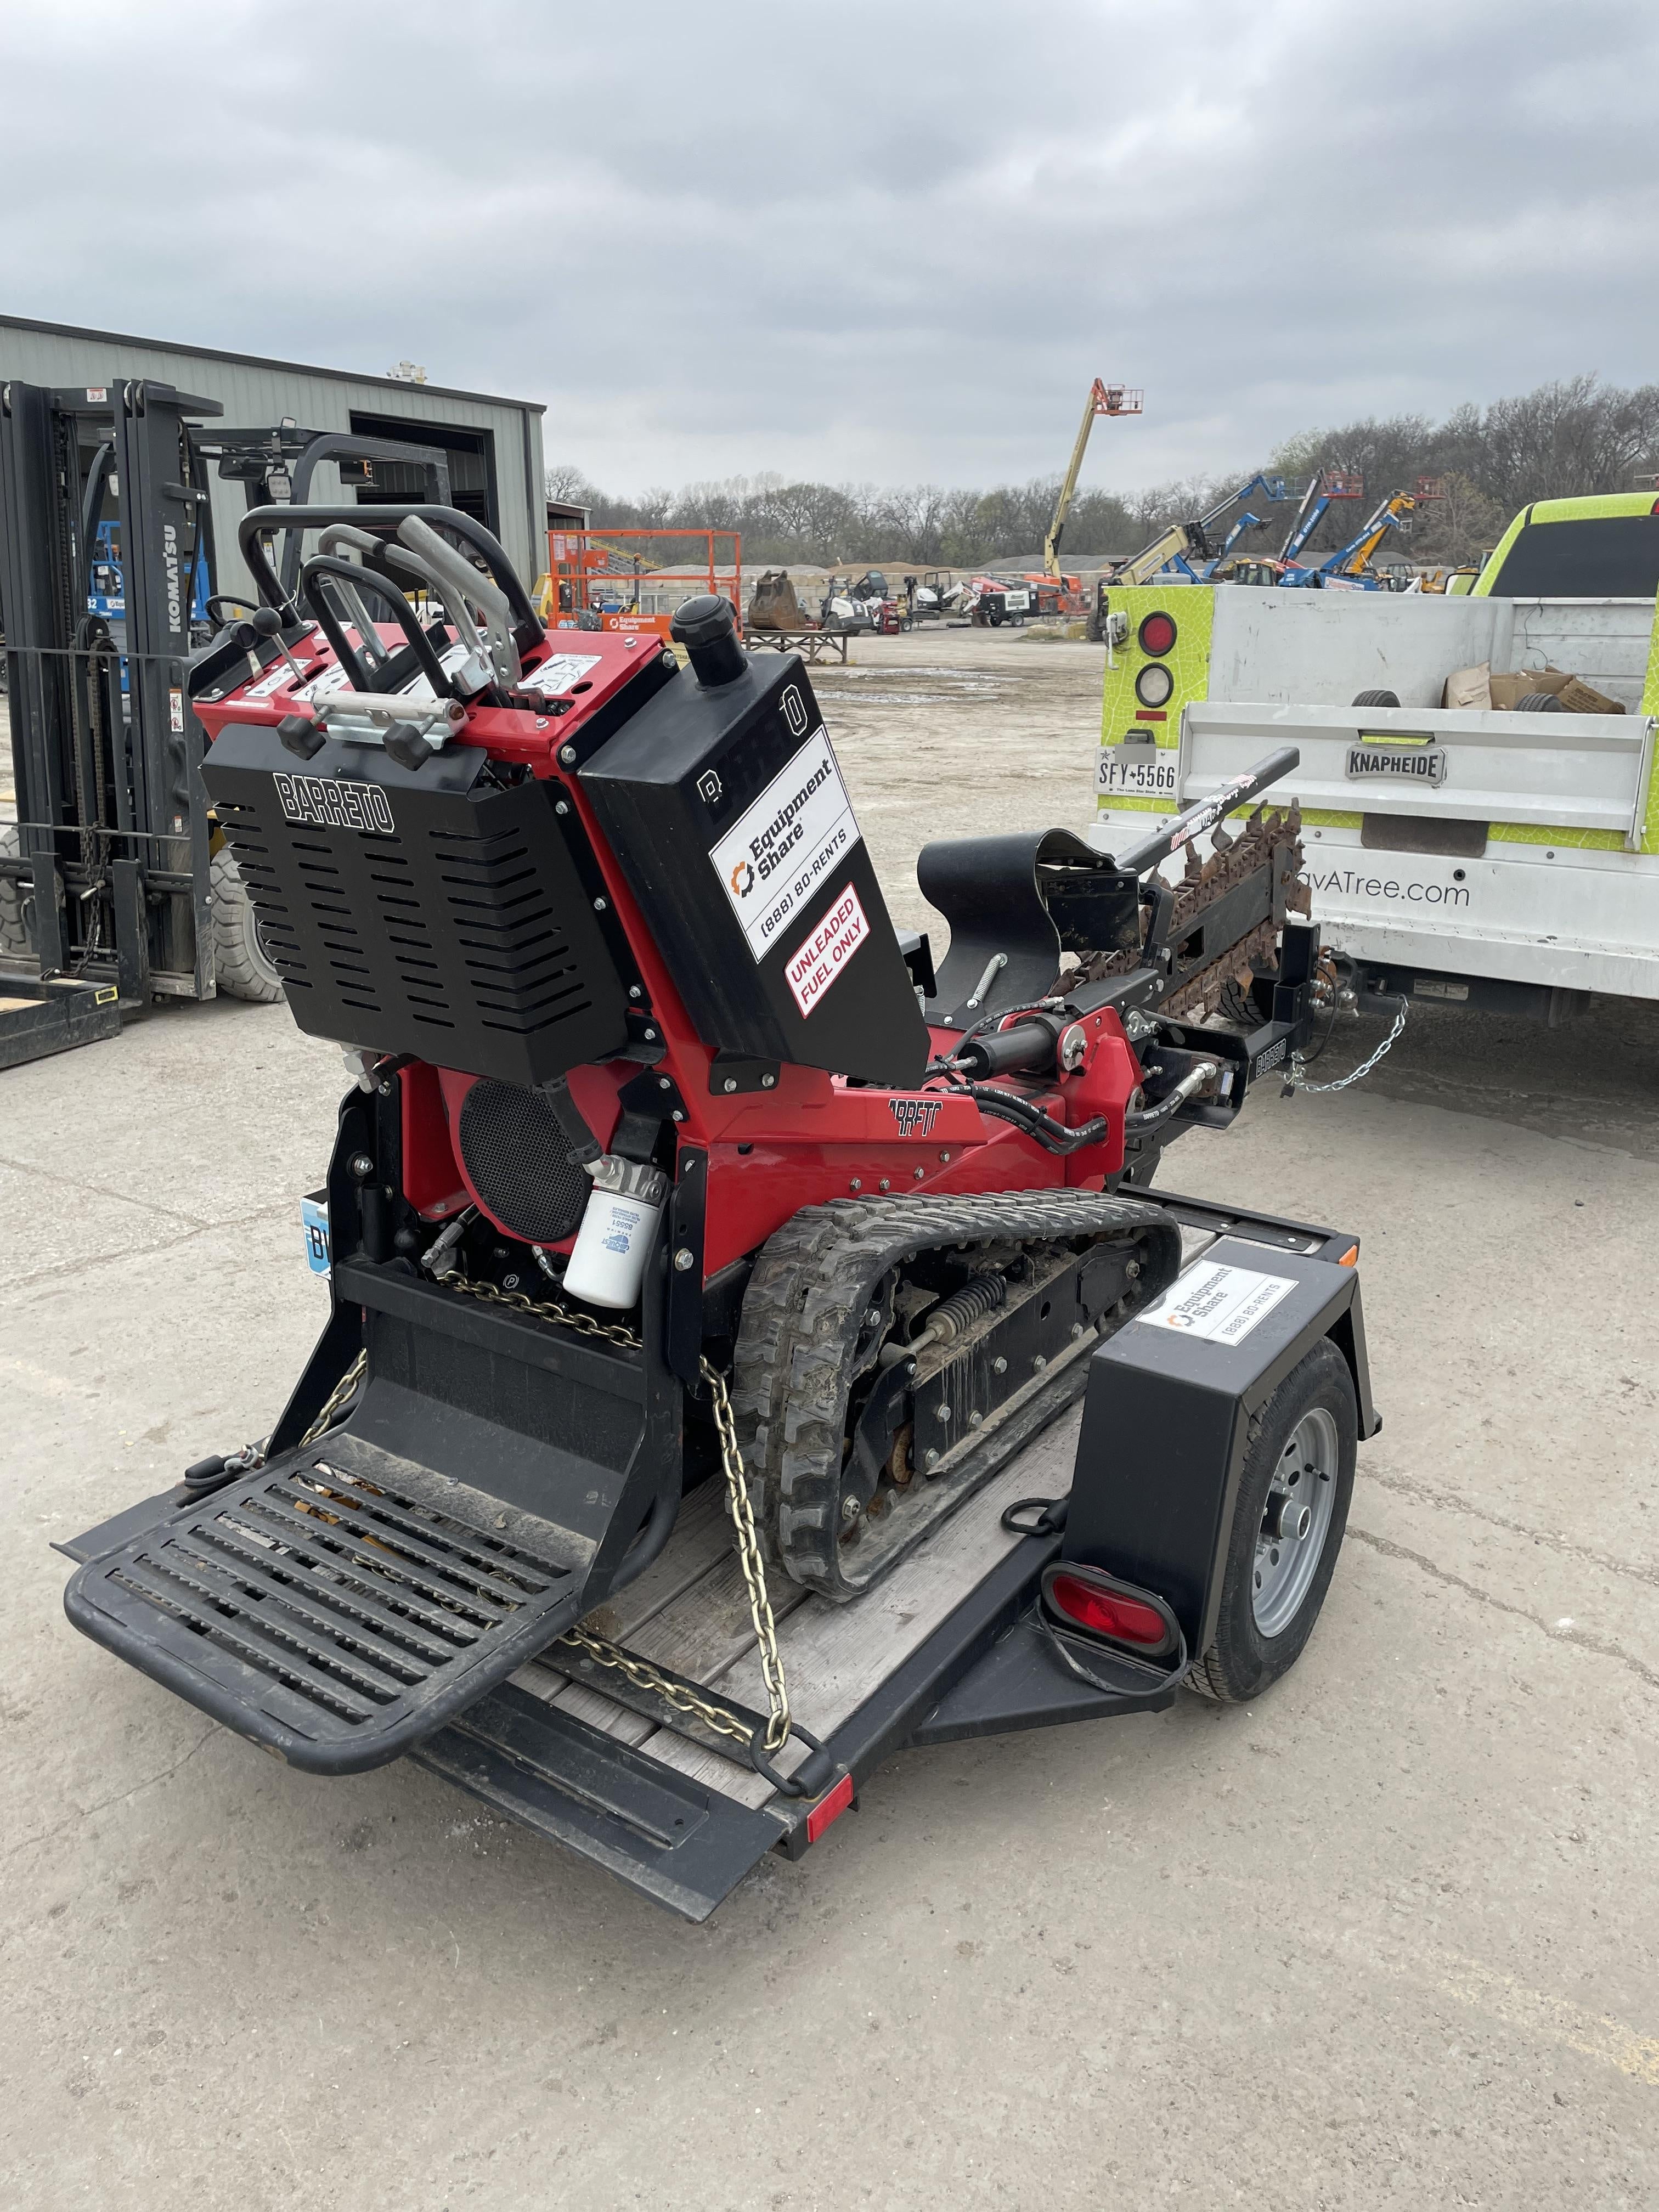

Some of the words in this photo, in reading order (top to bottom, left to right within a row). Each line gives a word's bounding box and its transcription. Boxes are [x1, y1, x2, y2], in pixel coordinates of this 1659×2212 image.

[163, 525, 181, 633] KOMATSU
[1099, 763, 1128, 785] SFY
[1137, 764, 1175, 788] 5566
[1350, 751, 1438, 778] KNAPHEIDE
[273, 772, 395, 833] BARRETO
[748, 759, 832, 860] Equipment
[757, 822, 804, 881] Share
[760, 893, 792, 939] (888)
[794, 829, 848, 896] 80-RENTS
[1295, 870, 1470, 906] avATree.com
[791, 897, 854, 984] UNLEADED
[800, 961, 832, 1005] FUEL
[831, 917, 866, 964] ONLY
[1256, 1038, 1286, 1079] BARRETO
[612, 1220, 633, 1230] 85551
[1173, 1267, 1233, 1313] Equipment
[1192, 1291, 1228, 1318] Share
[1222, 1316, 1249, 1335] (888)
[1243, 1284, 1281, 1316] 80-RENTS
